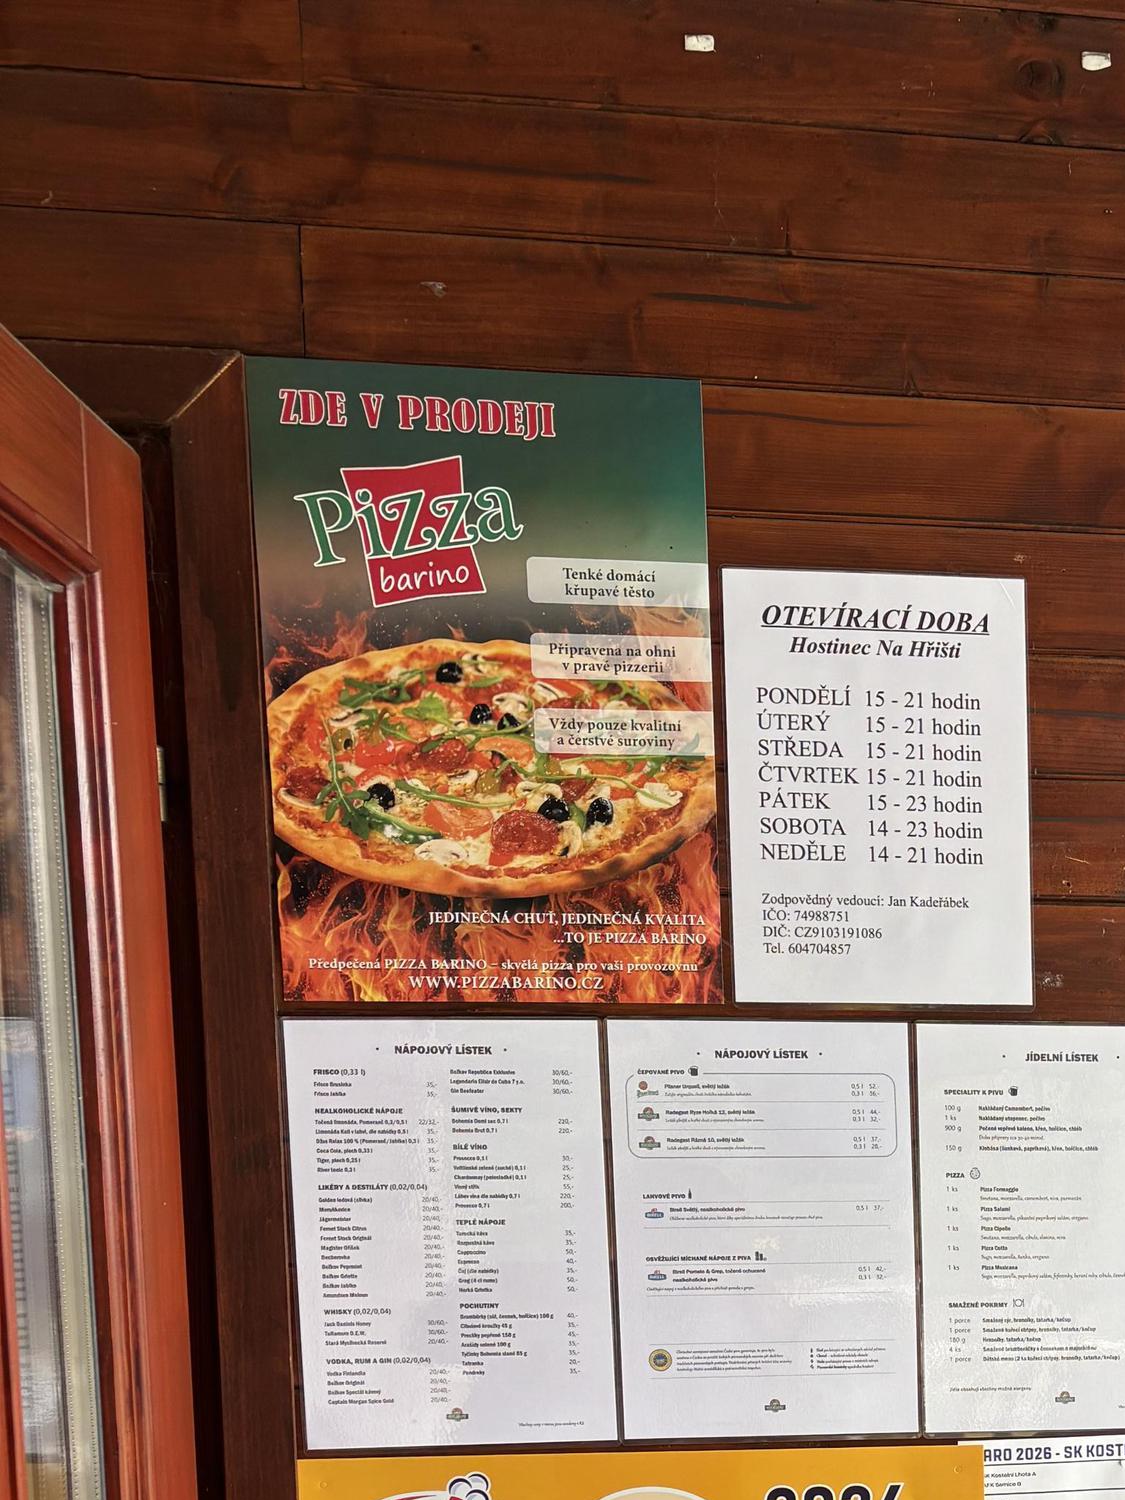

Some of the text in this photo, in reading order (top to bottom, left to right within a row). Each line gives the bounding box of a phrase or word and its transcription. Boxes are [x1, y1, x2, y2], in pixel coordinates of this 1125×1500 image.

[279, 388, 555, 441] ZDE V PRODEJI
[294, 485, 524, 568] Pizza
[379, 562, 470, 594] barino
[562, 568, 656, 583] Tenké domácí
[565, 584, 655, 599] křupavé těsto
[761, 602, 990, 635] OTEVÍRACÍ DOBA
[550, 643, 676, 658] Připravena ohni
[789, 636, 961, 658] Hostinec Na Hřišti
[574, 661, 663, 674] pravé pizzerii
[756, 684, 981, 710] PONDĚLÍ 15 21 hodin
[550, 718, 681, 733] Vždy pouze kvalitní
[757, 709, 831, 731] ÚTERÝ
[568, 735, 675, 750] čerstvé suroviny
[758, 736, 844, 758] STŘEDA
[758, 761, 859, 784] ČTVRTEK
[759, 787, 831, 810] PÁTEK
[759, 817, 846, 835] SOBOTA
[760, 840, 983, 865] NEDĚLE 14 21 hodin
[762, 893, 969, 908] Zodpovědný vedoucí: Jan Kadeřábek
[428, 911, 705, 926] JEDINEČNÁ CHUŤ, JEDINEČNÁ KVALITA
[762, 910, 849, 922] IČO: 74988751
[763, 924, 882, 939] DIČ: CZ9103191086
[763, 943, 851, 954] Tel. 604704857
[409, 974, 604, 992] WWW.PIZZABARINO.CZ
[394, 1043, 492, 1055] NÁPOJOVÝ LÍSTEK
[714, 1047, 808, 1059] NÁPOJOVÝ LÍSTEK
[1025, 1051, 1099, 1063] JÍDELNÍ LÍSTEK
[944, 1088, 980, 1096] SPECIALITY
[1017, 1447, 1051, 1460] 2026
[1064, 1445, 1082, 1458] SK
